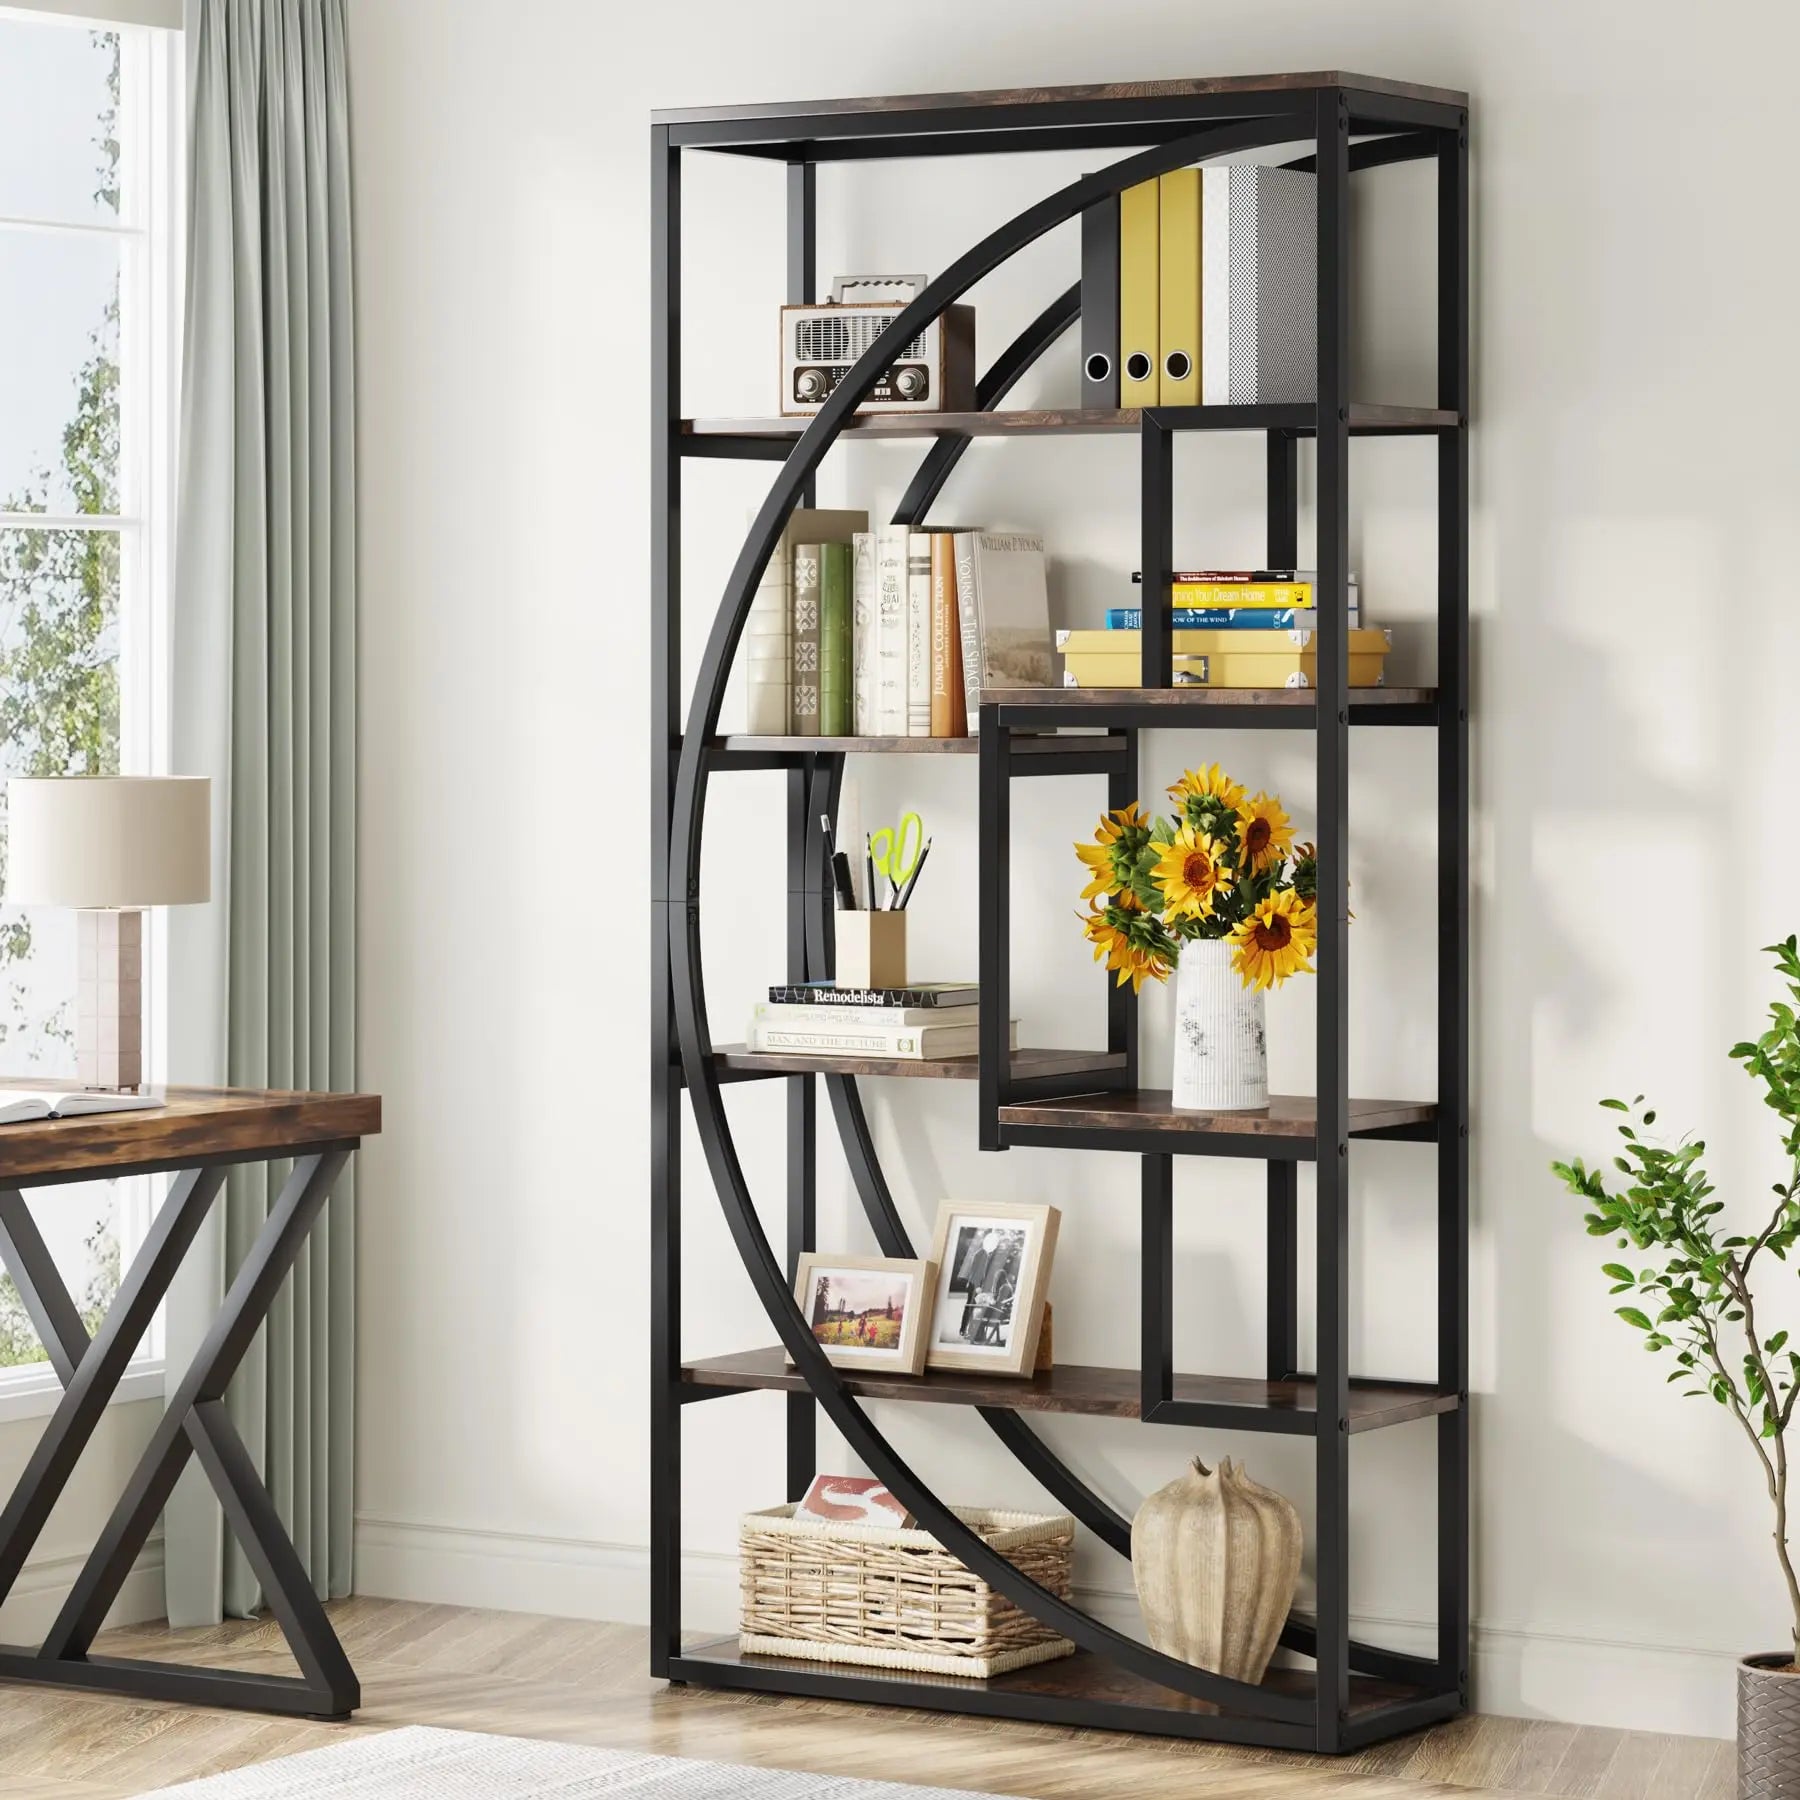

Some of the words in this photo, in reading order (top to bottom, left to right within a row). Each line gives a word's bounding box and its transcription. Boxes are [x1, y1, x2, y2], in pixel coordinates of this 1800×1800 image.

[980, 535, 1011, 552] WILLIAM
[1018, 536, 1044, 552] YOUNG
[959, 556, 973, 605] YOUNG
[1213, 587, 1239, 602] Dream
[1241, 587, 1266, 602] Home
[934, 576, 945, 652] COLLECTION
[962, 619, 977, 647] THE
[934, 655, 947, 696] JUMBO
[965, 650, 980, 695] SHACK
[814, 988, 884, 1005] Remodelista
[767, 1034, 791, 1045] MAN
[794, 1036, 816, 1046] AND
[821, 1037, 842, 1047] THE
[845, 1038, 887, 1049] FUTURE
